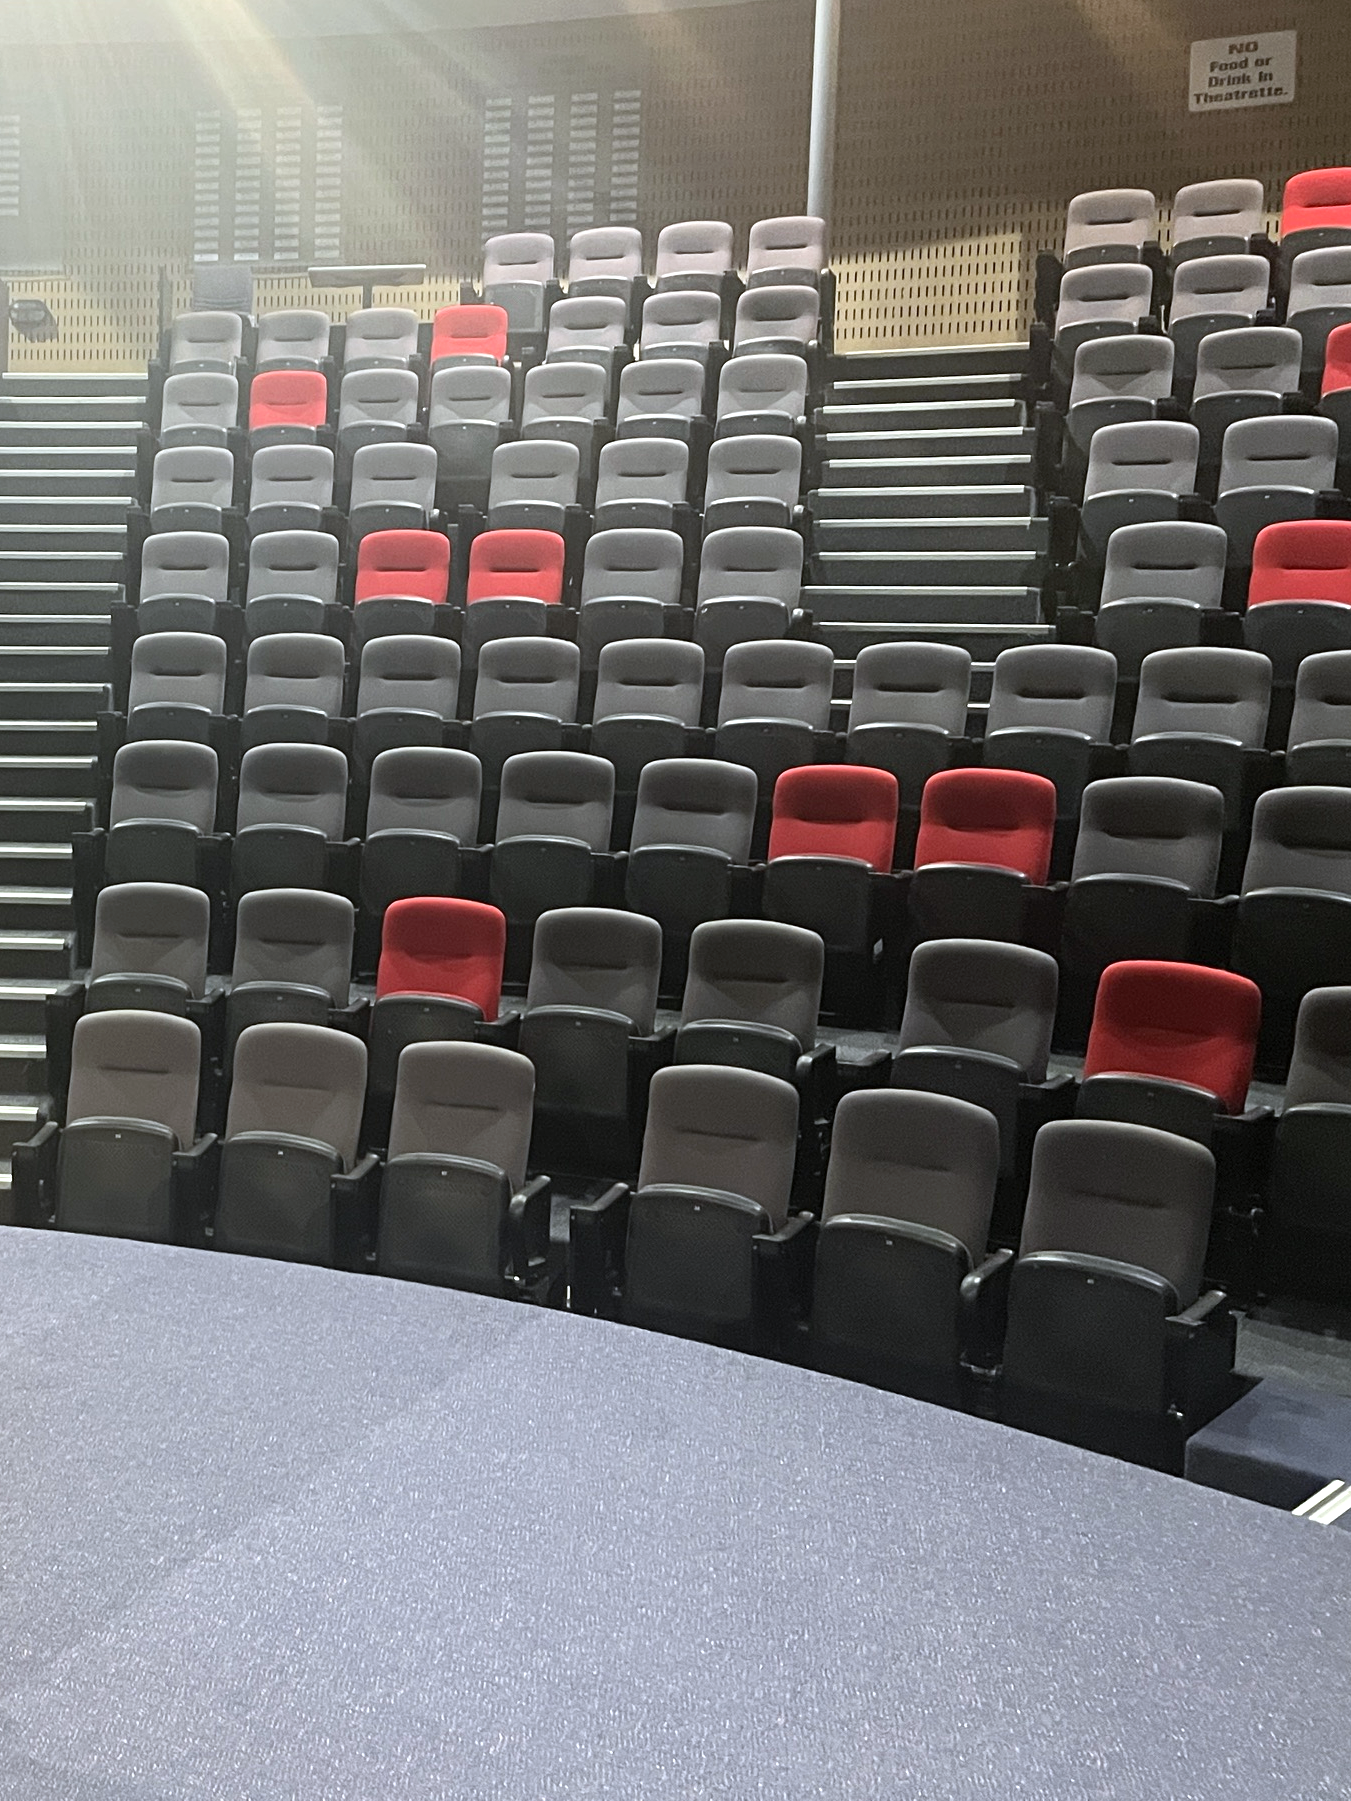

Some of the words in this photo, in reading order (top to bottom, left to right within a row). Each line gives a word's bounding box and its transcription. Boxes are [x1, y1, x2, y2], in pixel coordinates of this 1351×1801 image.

[1229, 41, 1258, 54] NO
[1210, 57, 1248, 72] Food
[1255, 57, 1272, 67] or
[1208, 73, 1251, 87] Drink
[1193, 87, 1288, 104] Theatrette.
